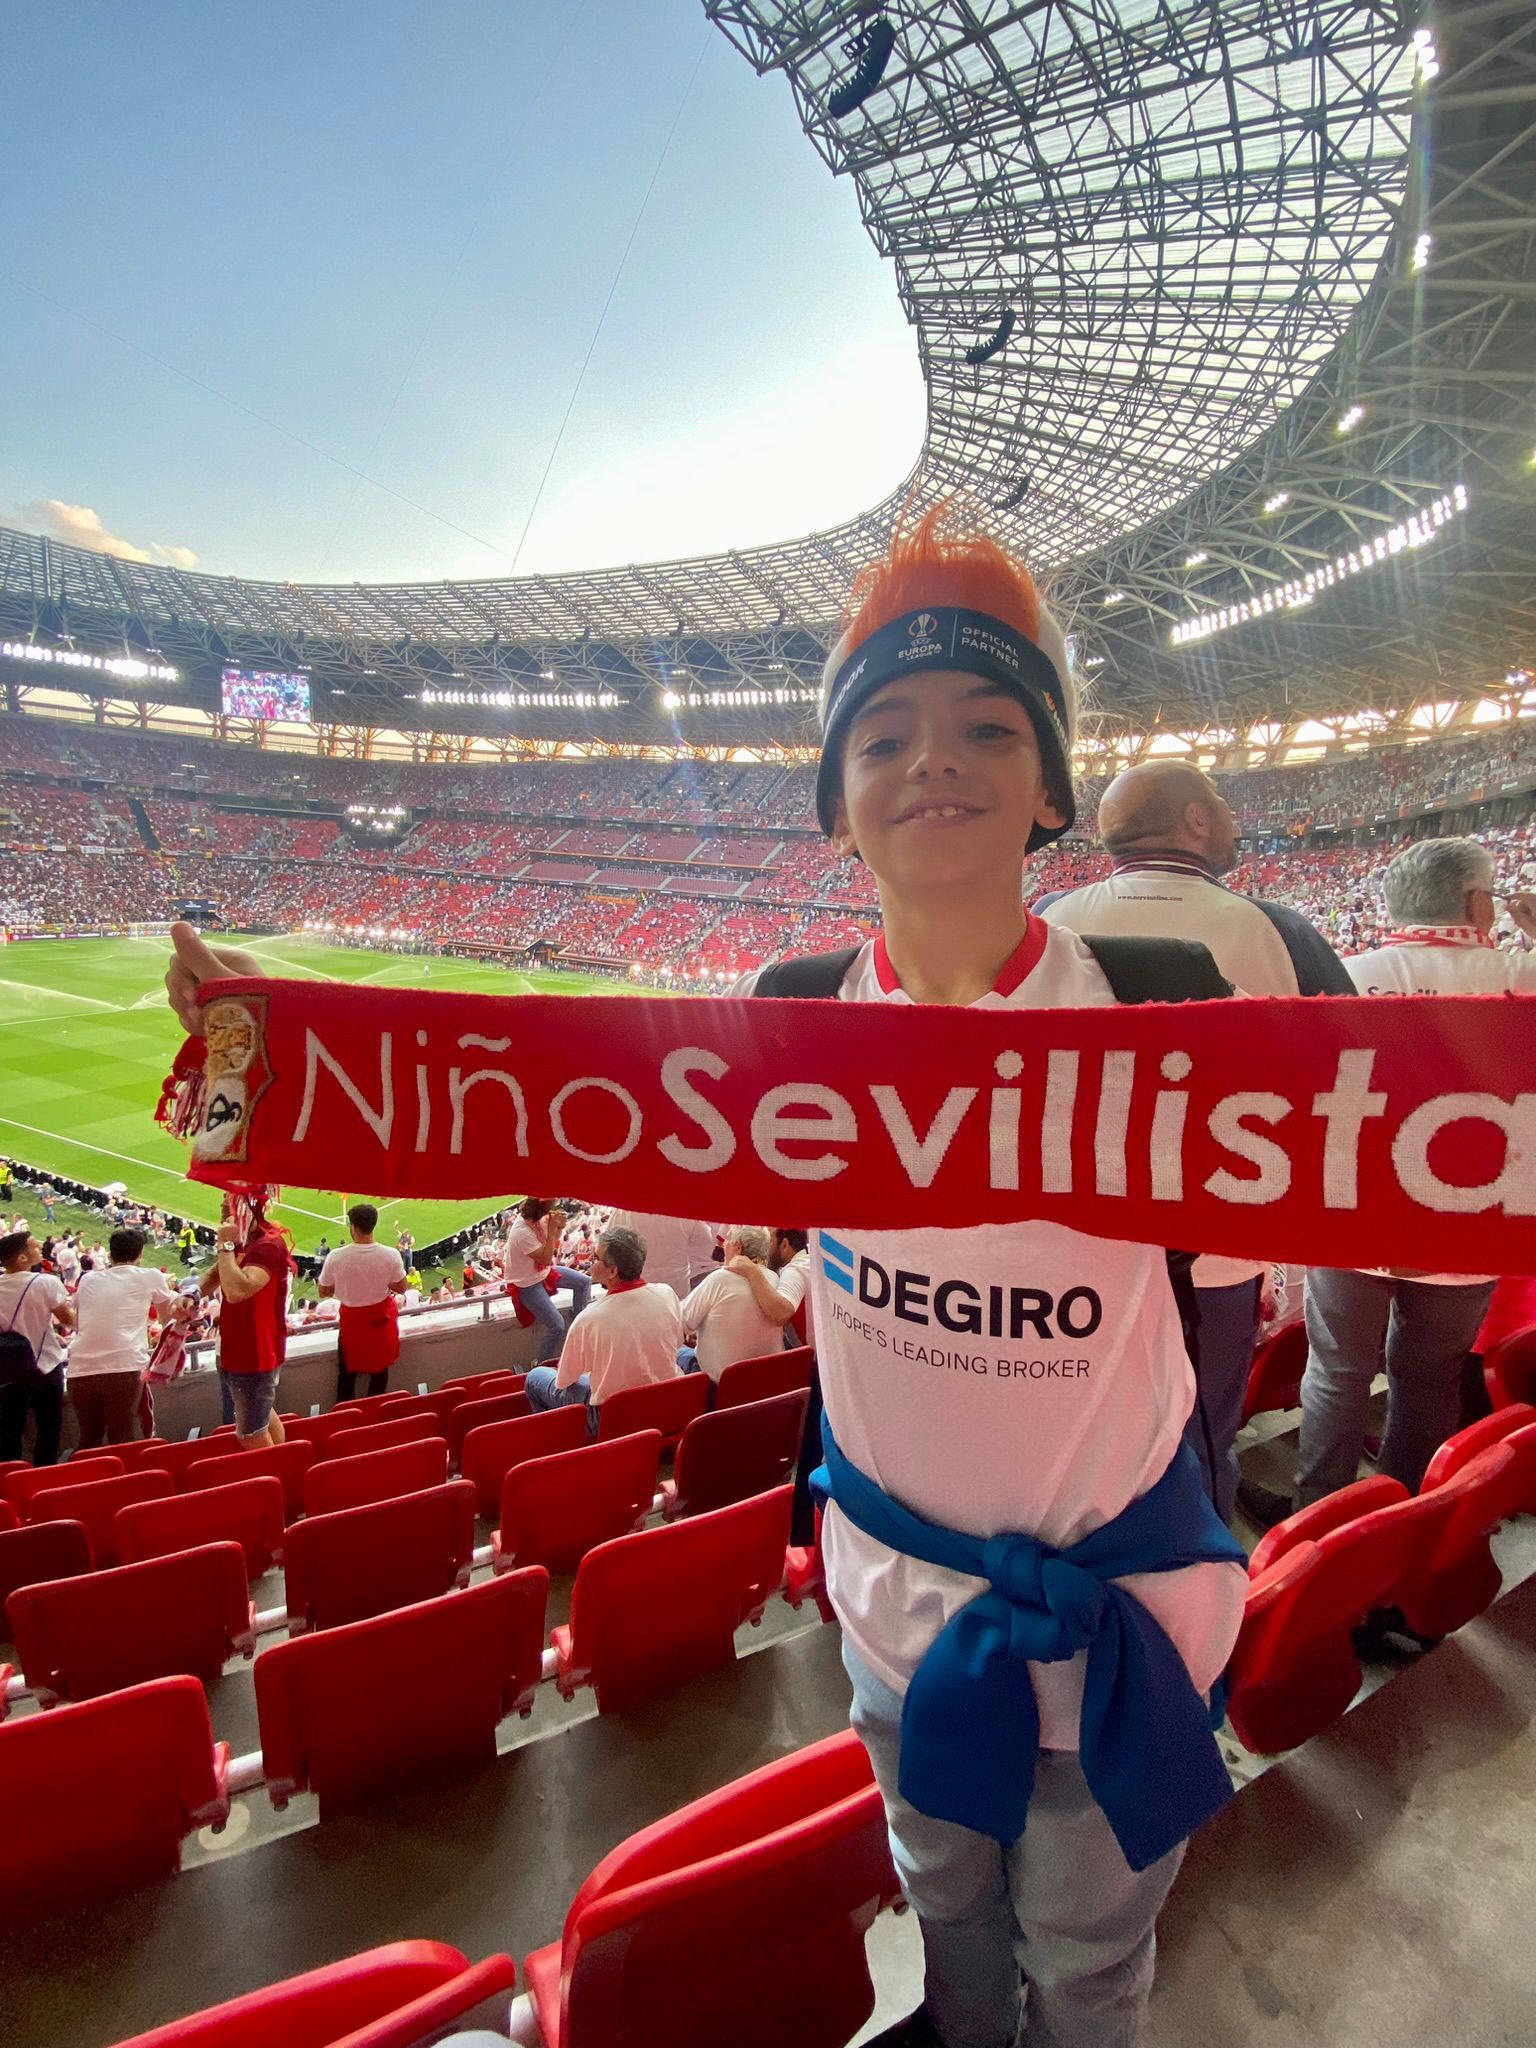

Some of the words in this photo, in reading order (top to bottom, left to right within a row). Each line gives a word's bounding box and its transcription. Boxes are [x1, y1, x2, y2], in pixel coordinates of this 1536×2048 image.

[898, 643, 942, 659] EUROPA
[907, 650, 932, 661] LEAGUE
[961, 637, 1019, 670] PARTNER
[962, 626, 1020, 658] OFFICIAL
[858, 1255, 1102, 1339] DEGIRO
[893, 1336, 988, 1375] LEADING
[997, 1359, 1090, 1379] BROKER
